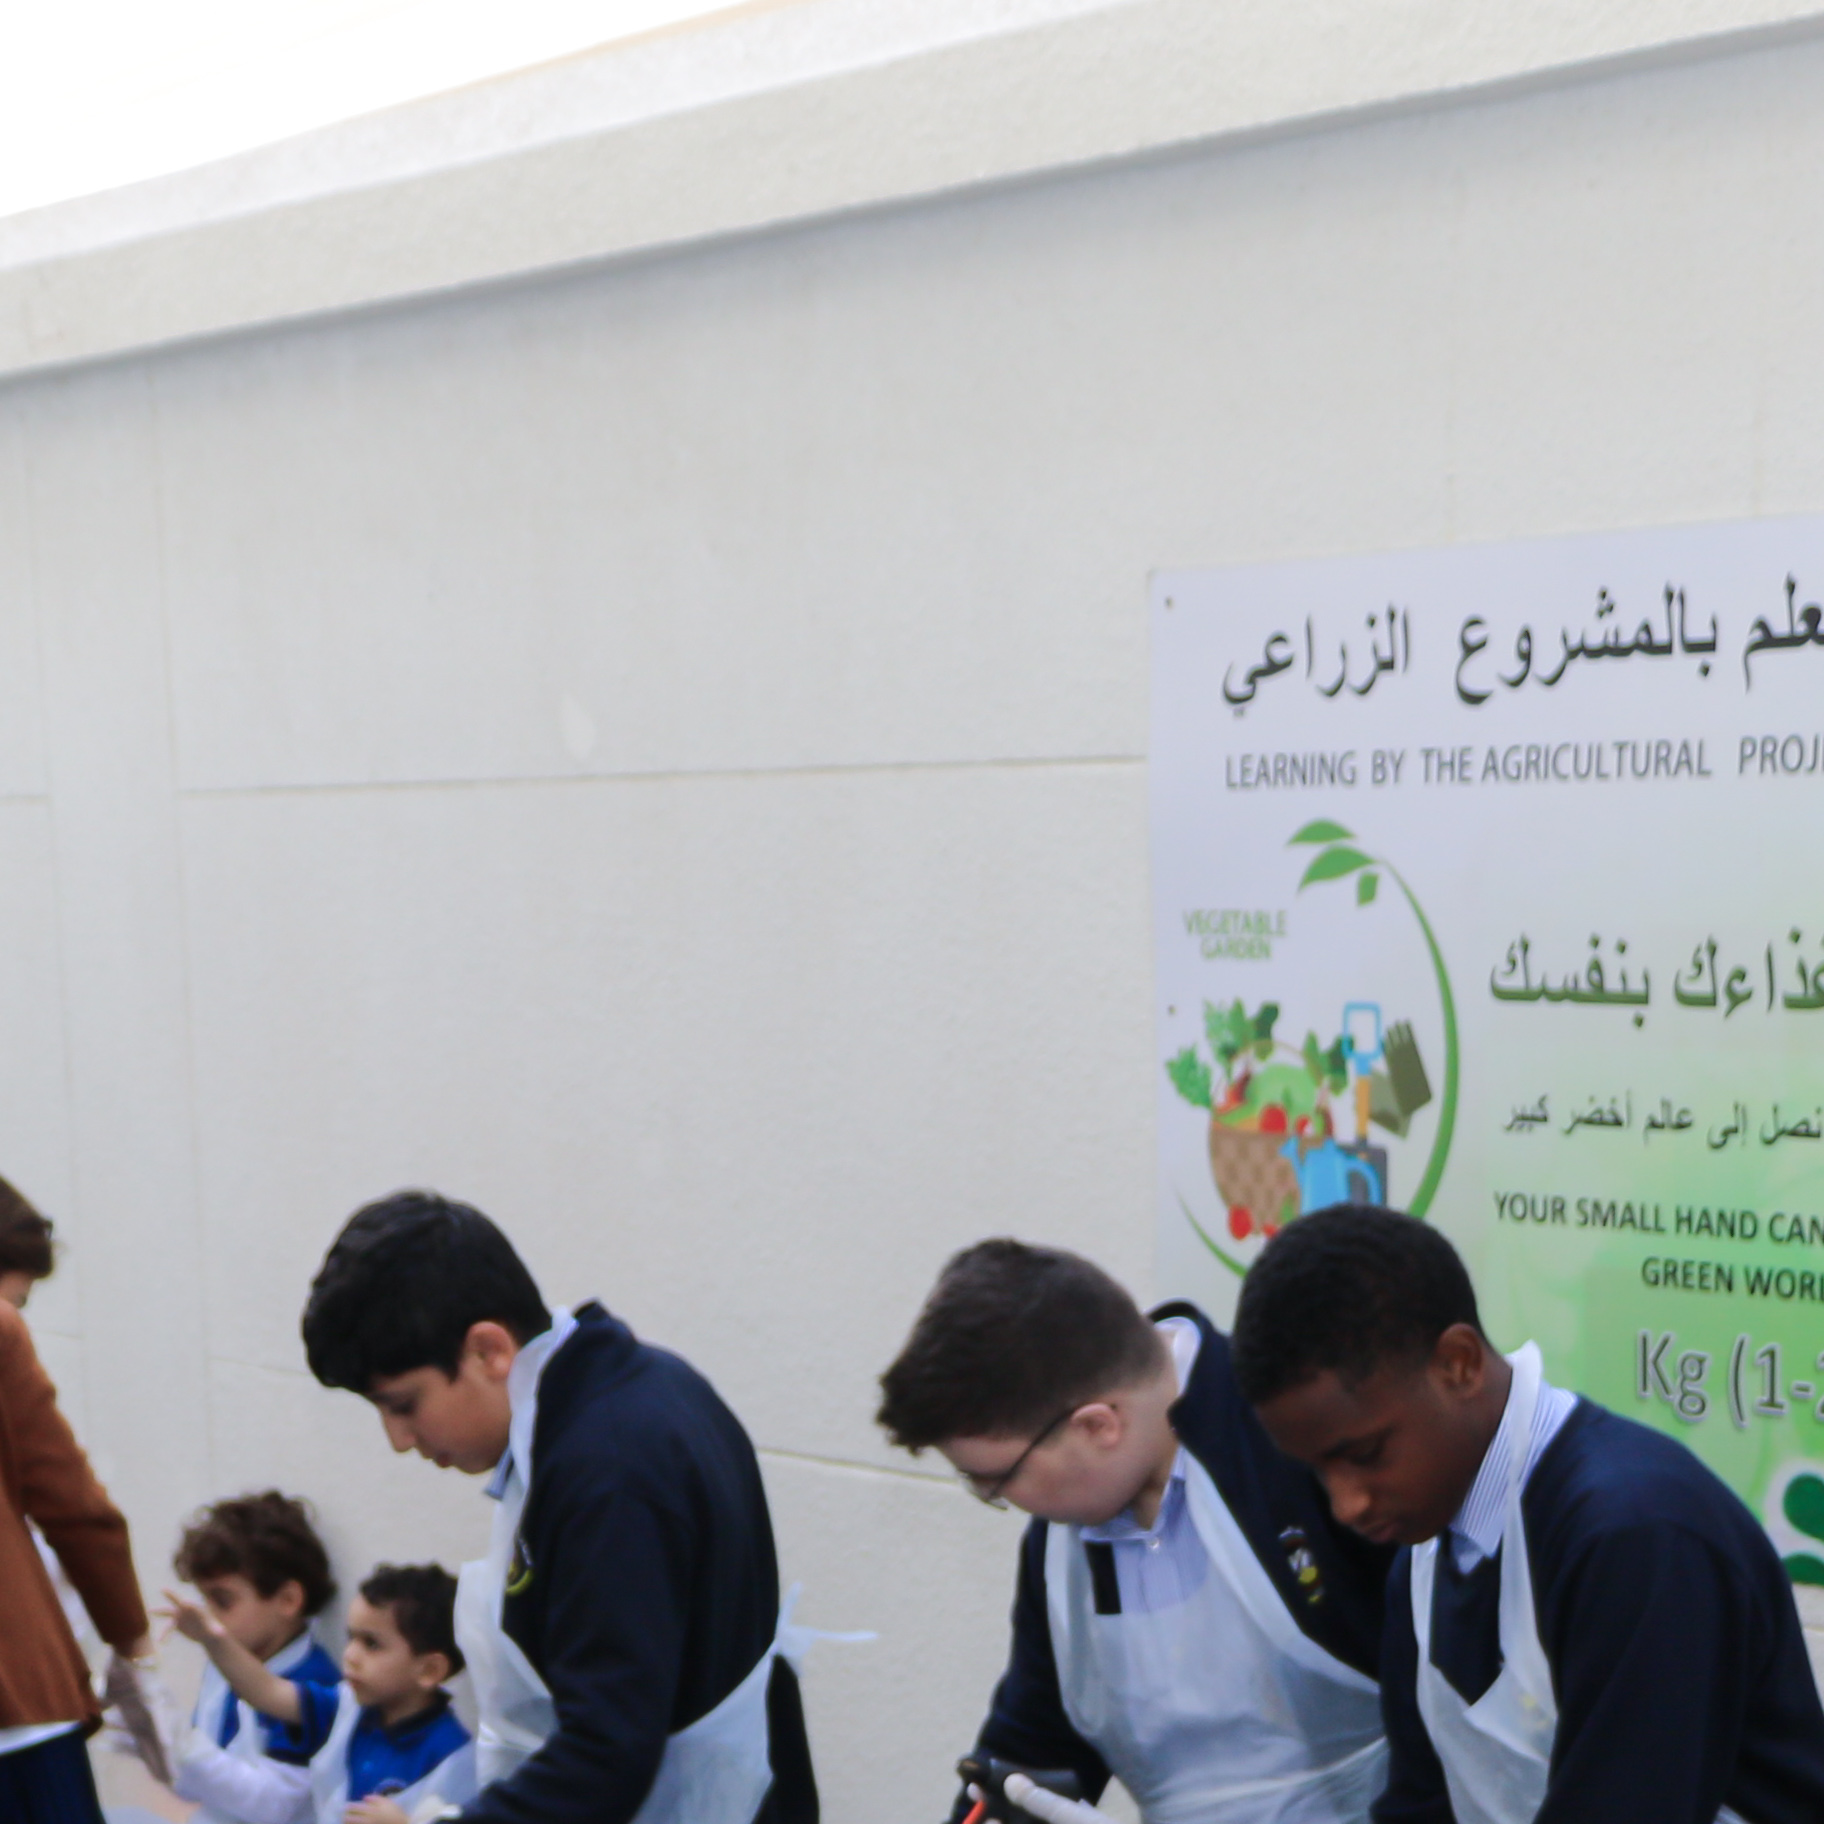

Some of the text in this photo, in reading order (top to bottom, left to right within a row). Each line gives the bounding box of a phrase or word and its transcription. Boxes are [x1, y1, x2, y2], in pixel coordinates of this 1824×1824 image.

[1222, 602, 1409, 719] الزراعي
[1455, 580, 1717, 706] بالمشروع
[1225, 751, 1357, 789] LEARNING
[1371, 749, 1406, 785] BY
[1420, 746, 1473, 783] THE
[1481, 738, 1713, 782] AGRICULTURAL
[1181, 909, 1288, 936] VEGETABLE
[1200, 935, 1273, 960] GARDEN
[1490, 932, 1650, 1030] بنفسك
[1503, 1093, 1548, 1133] كبير
[1643, 1096, 1694, 1147] عالم
[1759, 1102, 1822, 1146] نصل
[1494, 1191, 1567, 1225] YOUR
[1576, 1198, 1666, 1233] SMALL
[1675, 1205, 1759, 1242] HAND
[1641, 1257, 1734, 1293] GREEN
[1638, 1330, 1711, 1422] Kg
